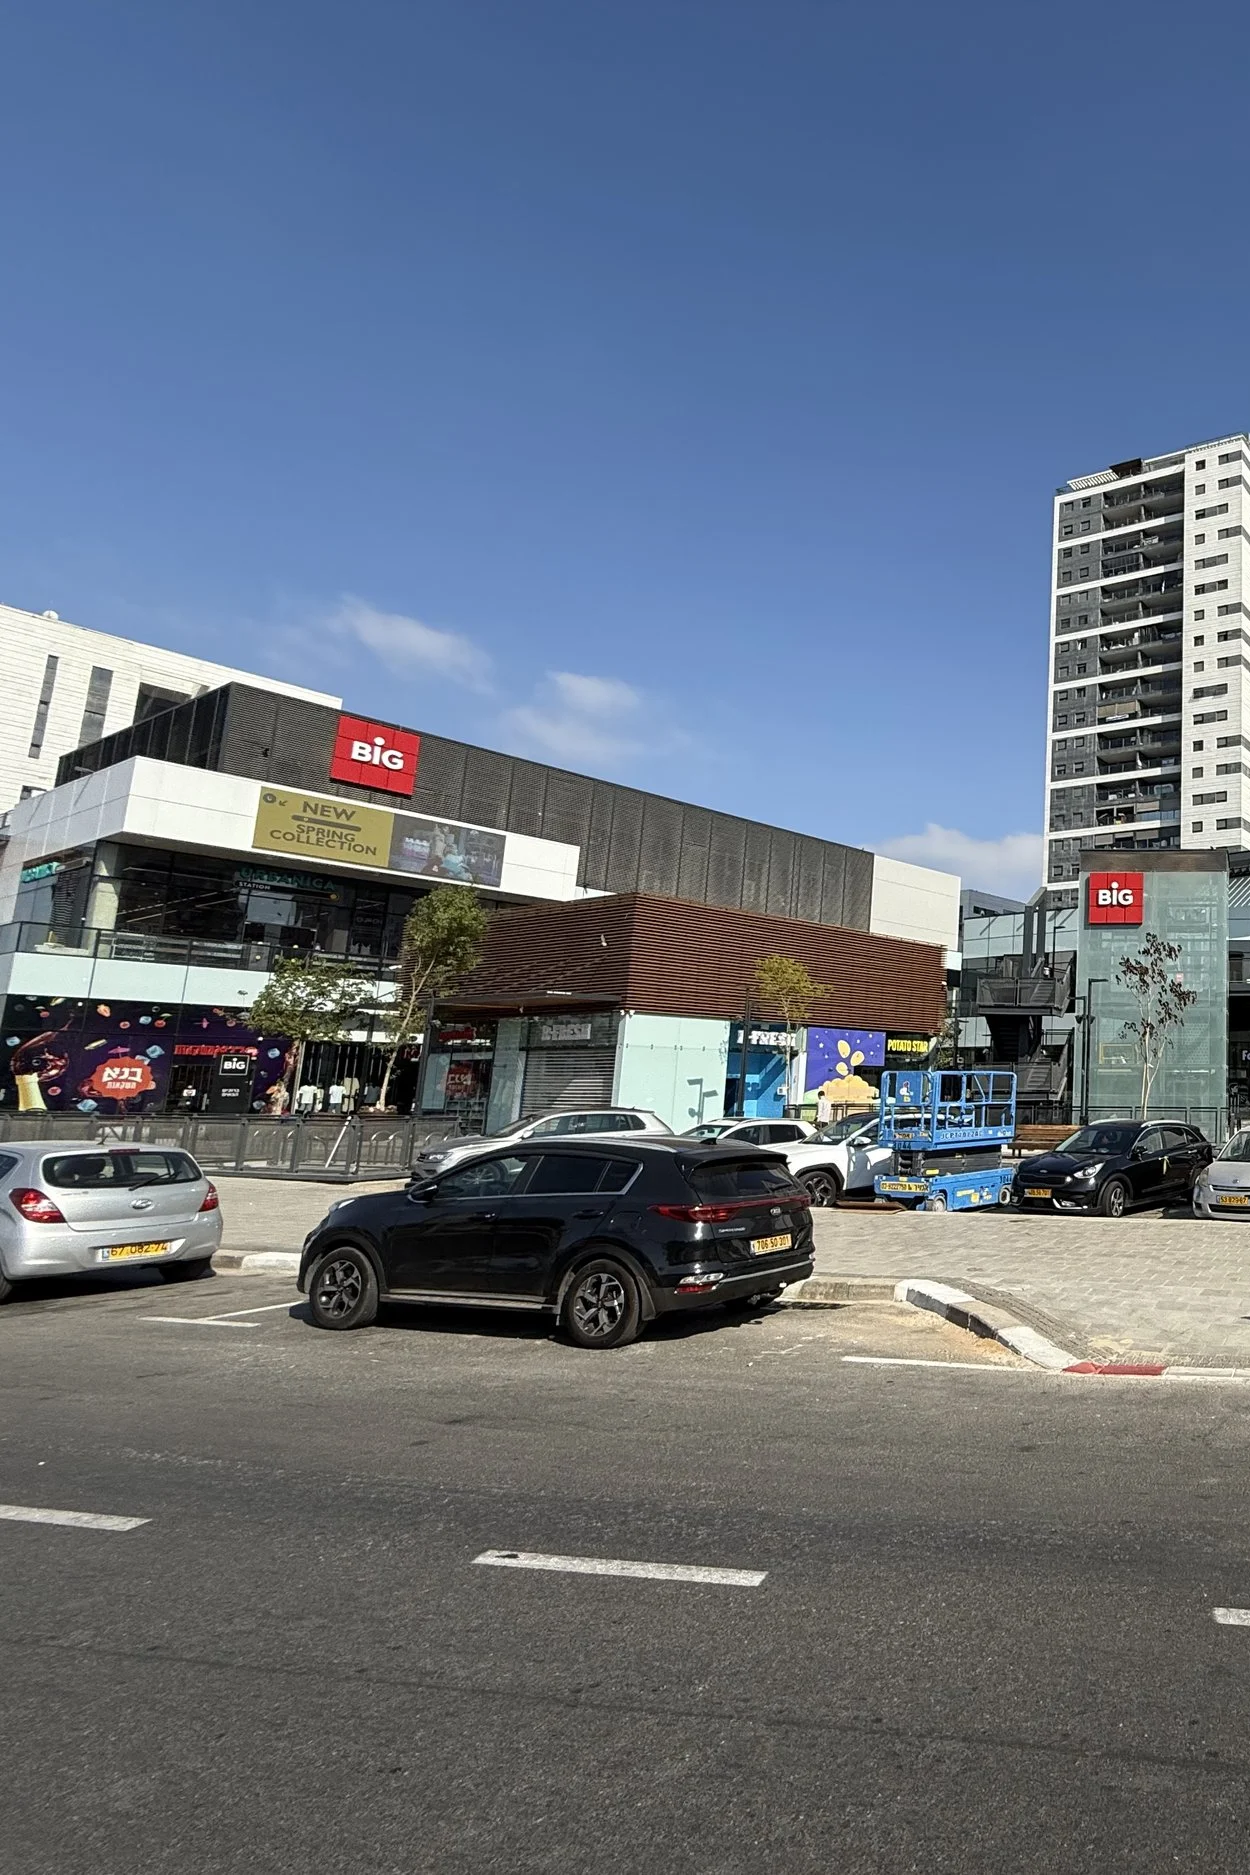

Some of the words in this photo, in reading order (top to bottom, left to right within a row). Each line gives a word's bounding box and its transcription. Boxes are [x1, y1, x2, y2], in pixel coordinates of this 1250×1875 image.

[302, 801, 356, 821] NEW
[270, 829, 377, 856] COLLECTION
[296, 824, 356, 843] SPRING
[238, 881, 271, 890] STATION
[239, 867, 336, 891] URBANICA
[888, 1039, 911, 1051] POTATO
[912, 1040, 928, 1052] STAR
